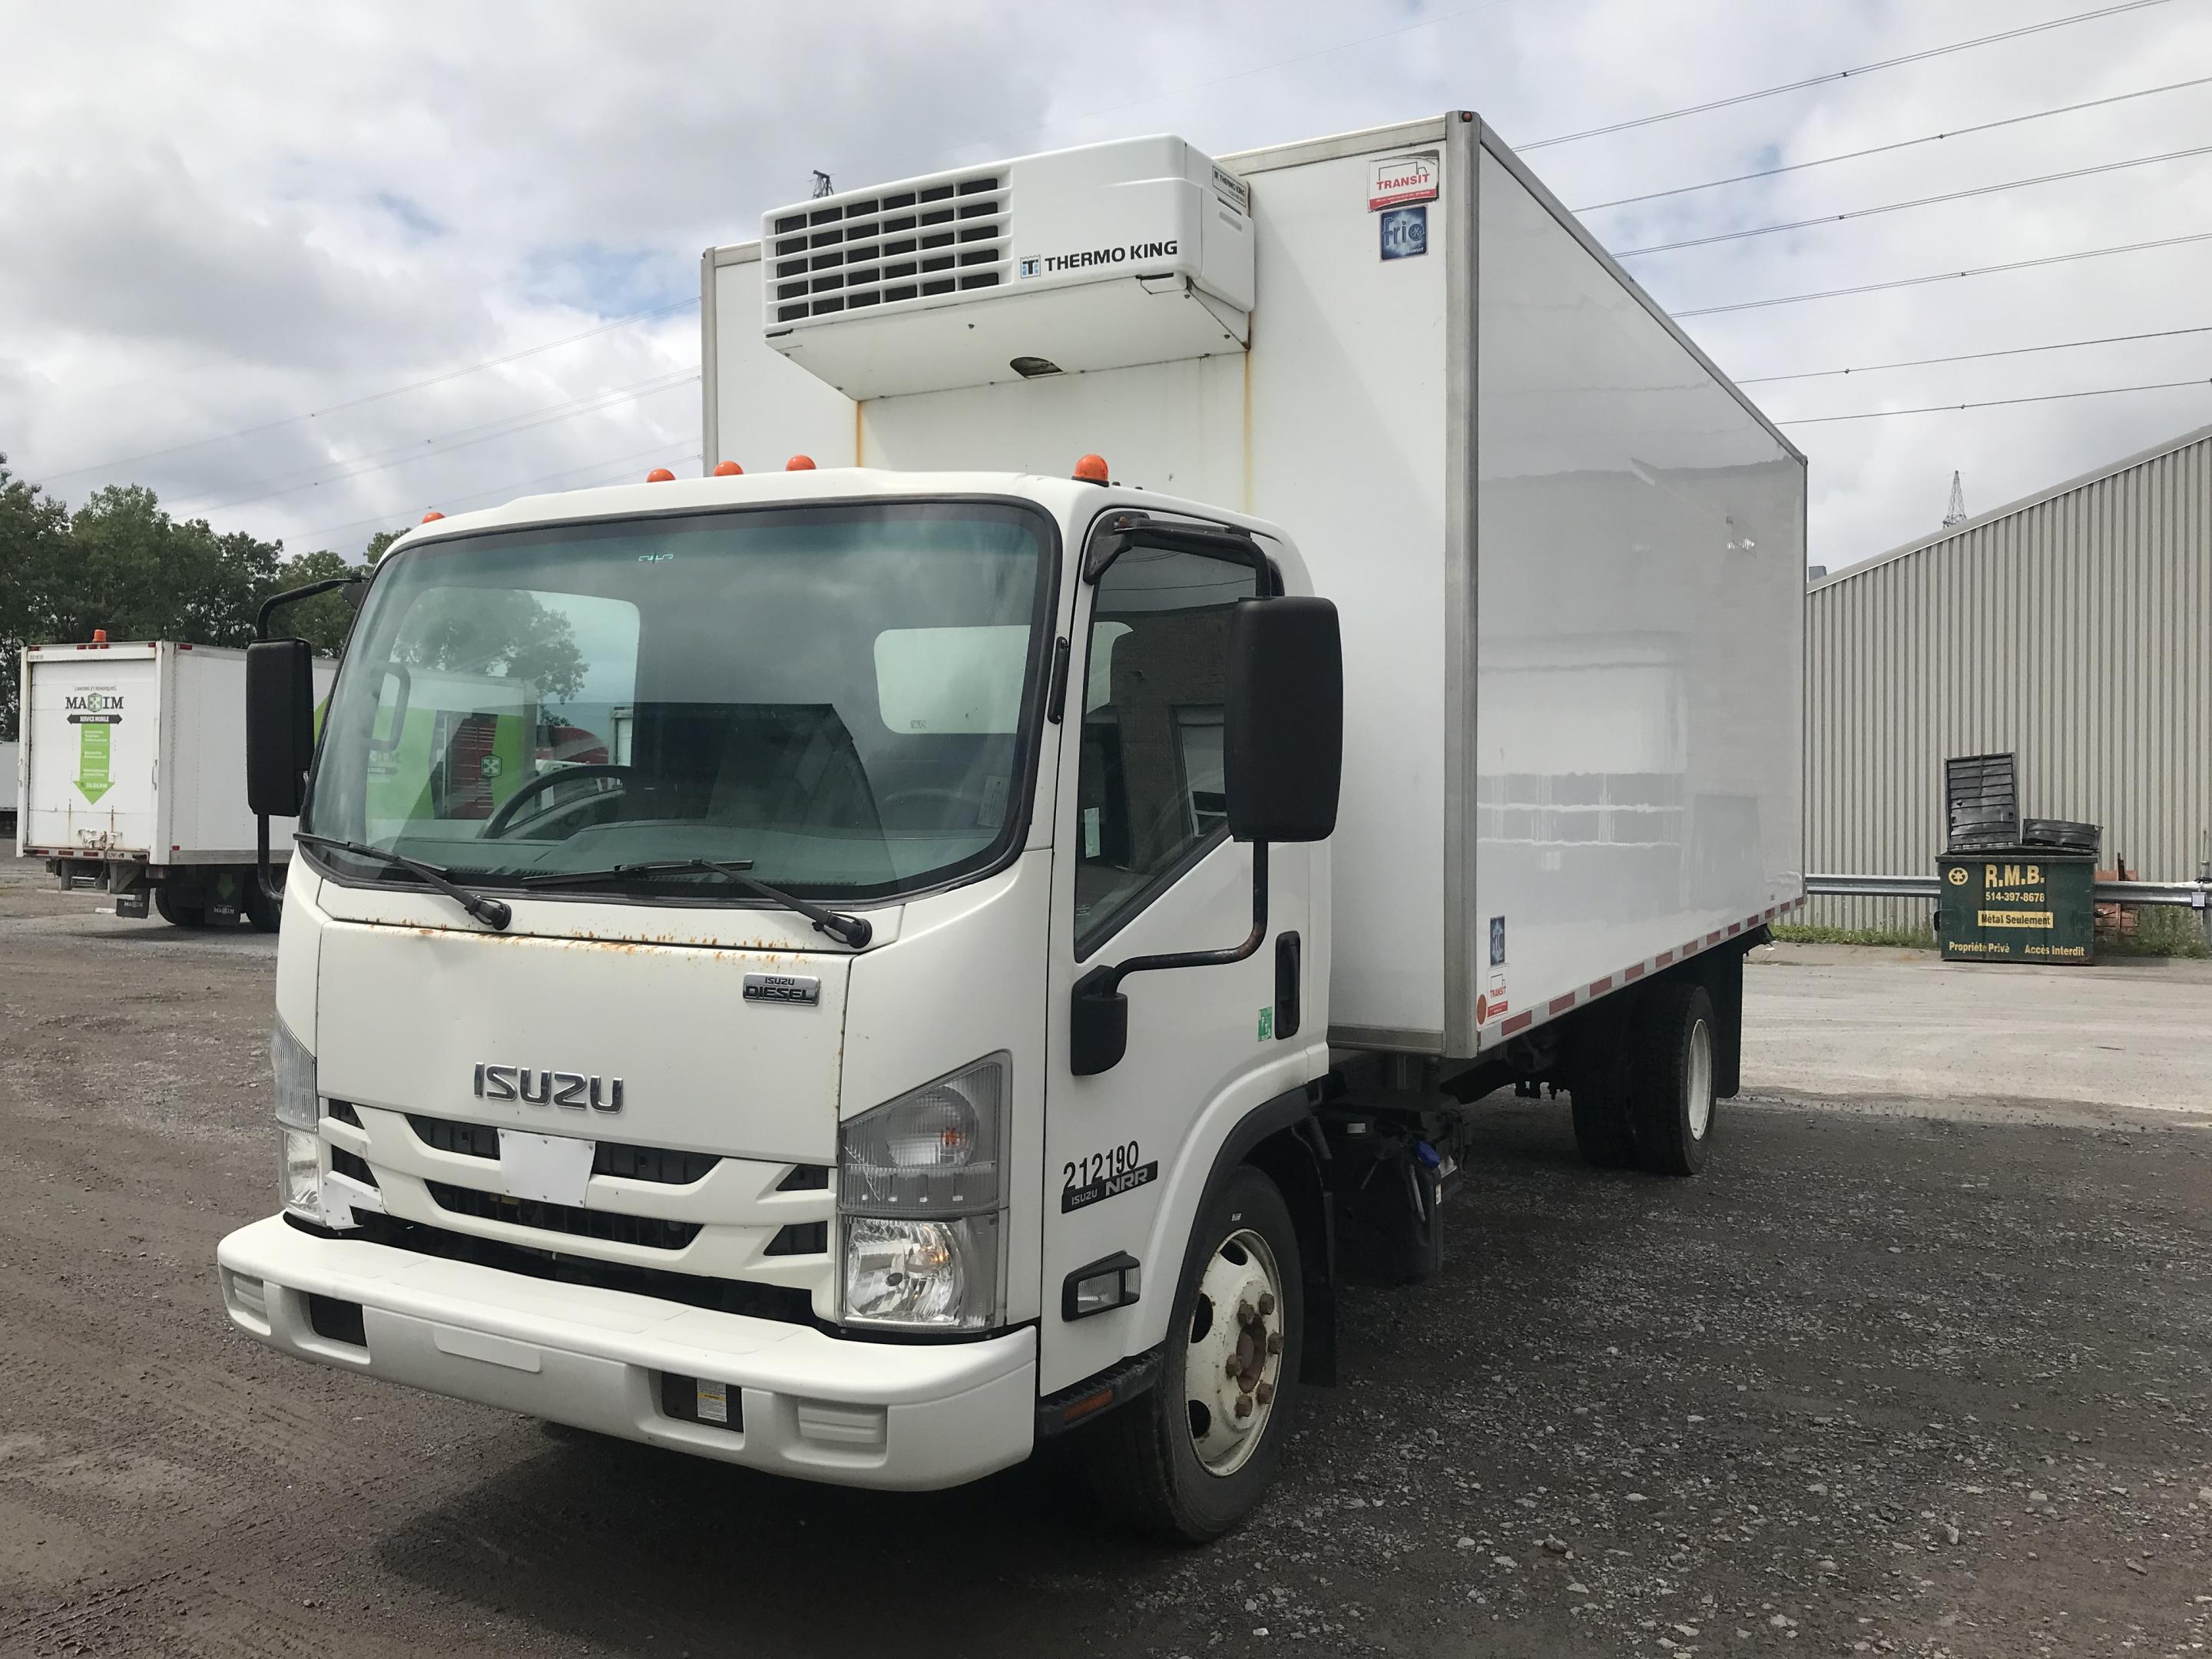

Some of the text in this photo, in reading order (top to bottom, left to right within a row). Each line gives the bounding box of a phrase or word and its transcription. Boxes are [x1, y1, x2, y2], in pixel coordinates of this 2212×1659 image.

[1376, 173, 1430, 190] TRANSIT
[1045, 247, 1126, 272] THERMO
[1130, 240, 1178, 260] KING
[65, 692, 124, 713] MAXIM
[1985, 864, 2045, 888] R.M.B.
[1985, 891, 2045, 902] 514-397-8678
[2005, 914, 2051, 926] Seulement
[2051, 945, 2085, 956] Interdit
[764, 977, 795, 985] ISUZU
[746, 985, 813, 1002] DIESEL
[1490, 985, 1507, 998] TRANSIT
[473, 1061, 624, 1114] ISUZU
[1063, 1140, 1139, 1194] 212190
[1071, 1167, 1148, 1206] ISUZU NRR
